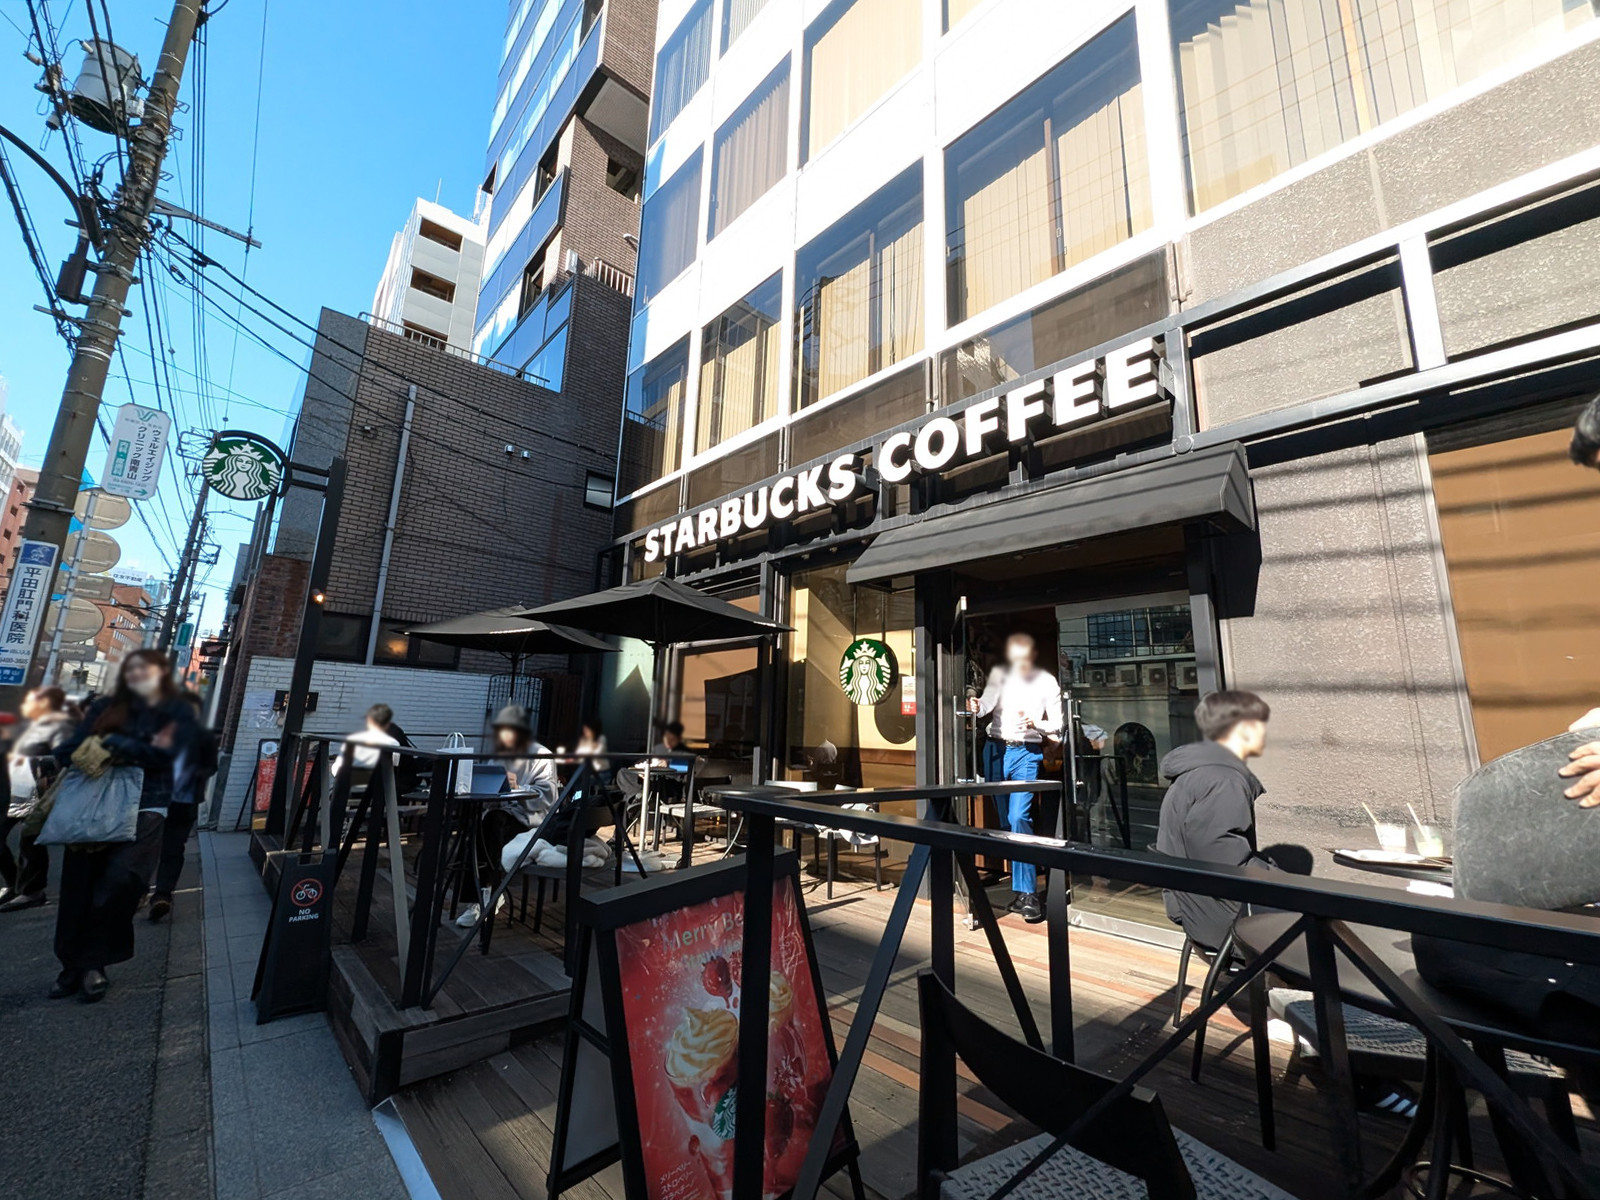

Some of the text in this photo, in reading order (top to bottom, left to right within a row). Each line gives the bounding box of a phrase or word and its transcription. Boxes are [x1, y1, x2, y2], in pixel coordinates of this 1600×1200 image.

[127, 425, 147, 480] クリニック南青山
[142, 428, 161, 482] ウェルエイジング
[643, 336, 1161, 564] STARBUCKS COFFEE
[6, 566, 41, 645] 平田肛門科医院
[289, 913, 319, 922] PARKING
[661, 920, 719, 954] Merry
[660, 1161, 691, 1185] メリーベリー
[661, 1171, 694, 1195] ストロベリー
